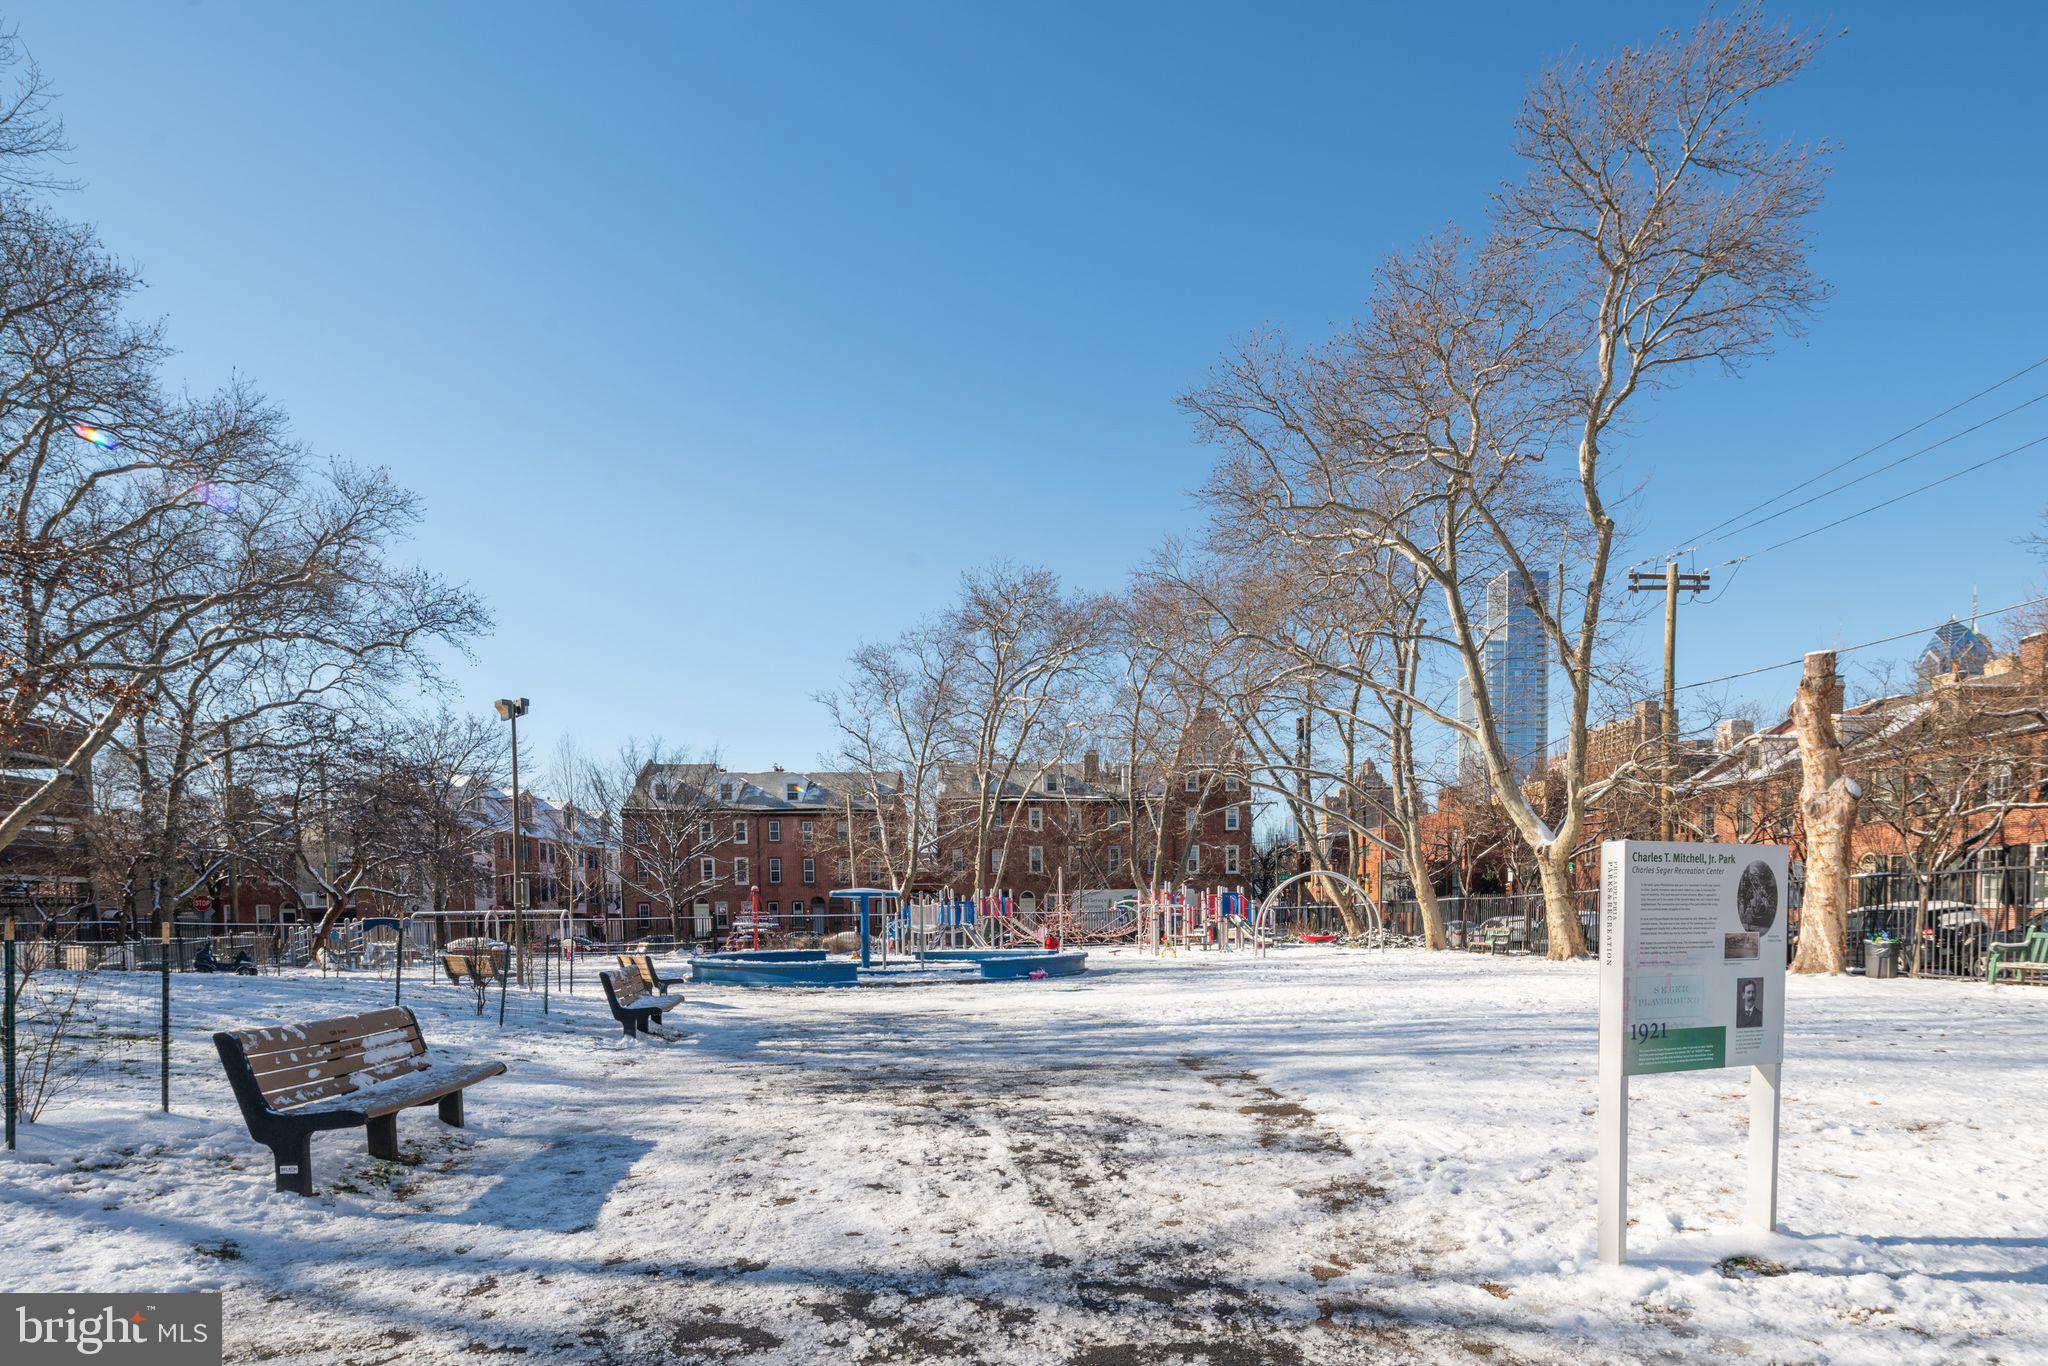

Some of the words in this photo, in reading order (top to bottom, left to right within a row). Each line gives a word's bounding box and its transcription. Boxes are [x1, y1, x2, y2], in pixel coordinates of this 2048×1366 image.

[1632, 852, 1662, 863] Charles
[1664, 853, 1671, 863] T.
[1673, 853, 1707, 865] Mitchell,
[1708, 854, 1717, 865] Jr.
[1719, 854, 1736, 864] Park
[1632, 866, 1655, 874] Charles
[1656, 866, 1674, 876] Seger
[1674, 867, 1705, 875] Recreation
[1631, 1022, 1668, 1045] 1921
